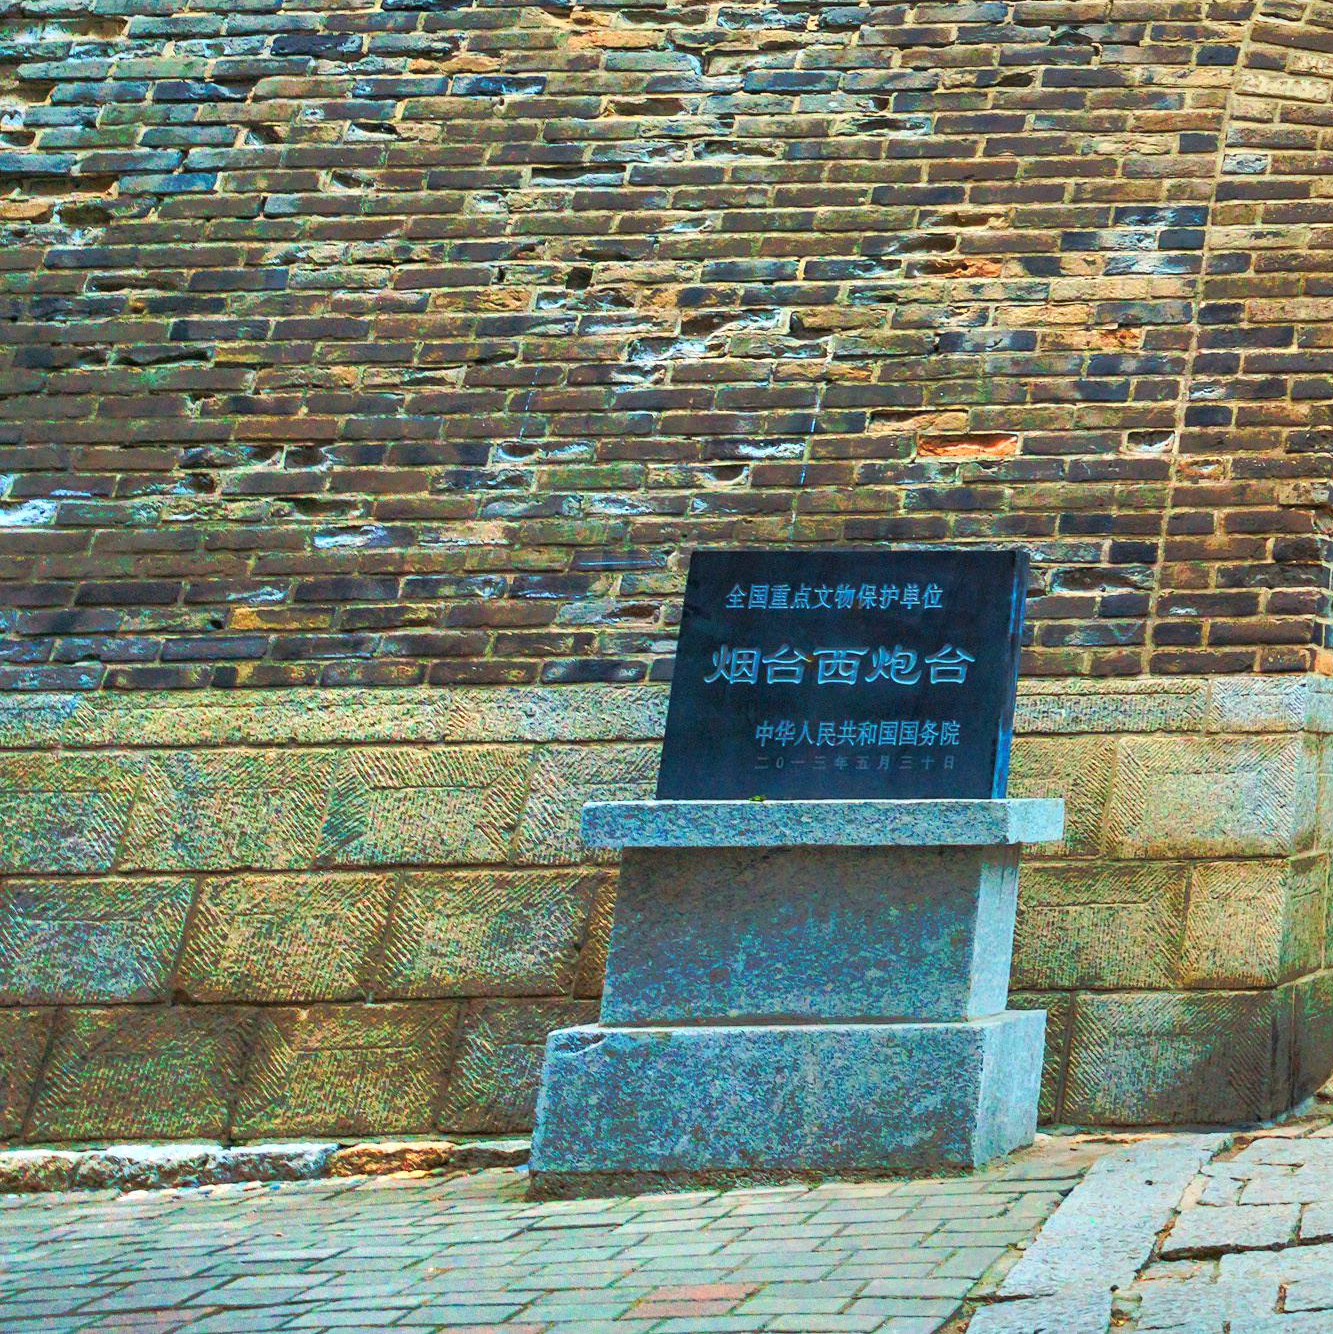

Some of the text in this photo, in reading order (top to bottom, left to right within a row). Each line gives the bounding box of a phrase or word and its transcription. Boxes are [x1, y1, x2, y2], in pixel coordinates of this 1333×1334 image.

[725, 583, 944, 610] 全国重点文物保护单位
[703, 643, 976, 685] 烟台西炮台
[755, 719, 961, 747] 中华人民共和国国务院
